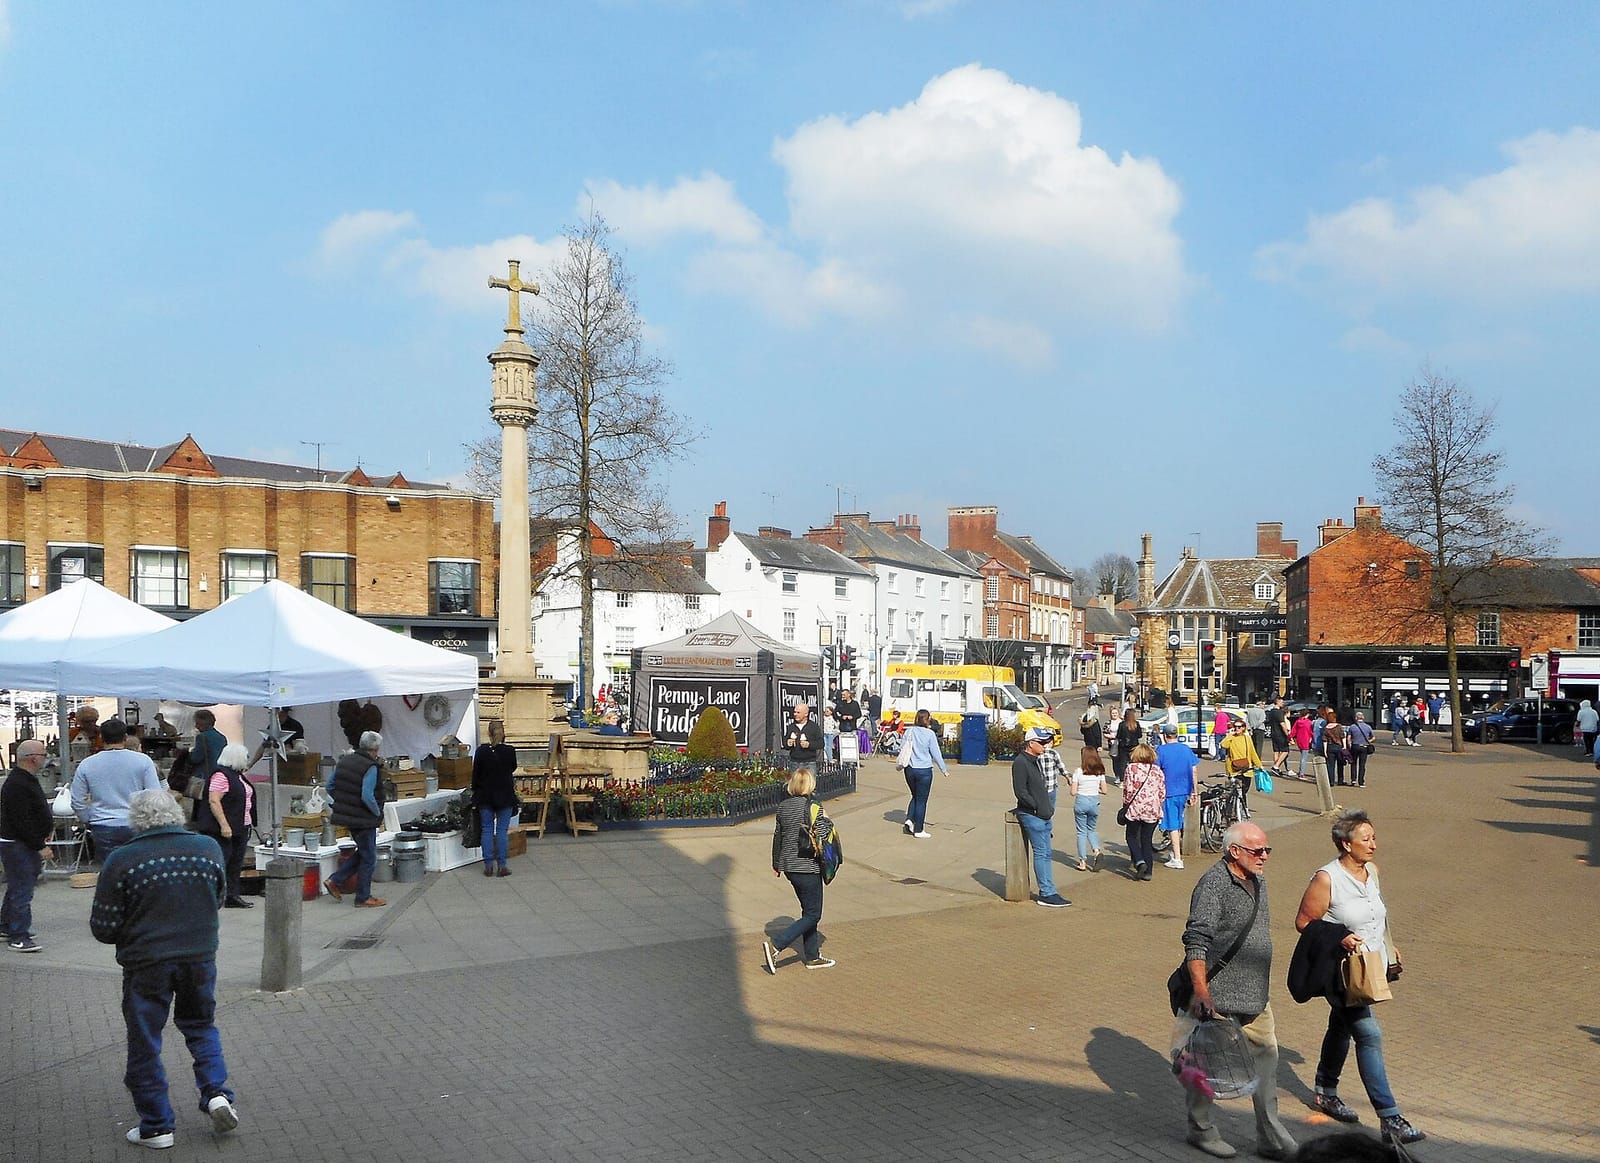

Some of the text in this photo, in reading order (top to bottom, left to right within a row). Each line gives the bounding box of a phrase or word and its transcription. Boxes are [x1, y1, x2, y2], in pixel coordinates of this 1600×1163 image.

[658, 685, 741, 711] Penny Lane
[656, 707, 701, 737] Fudg
